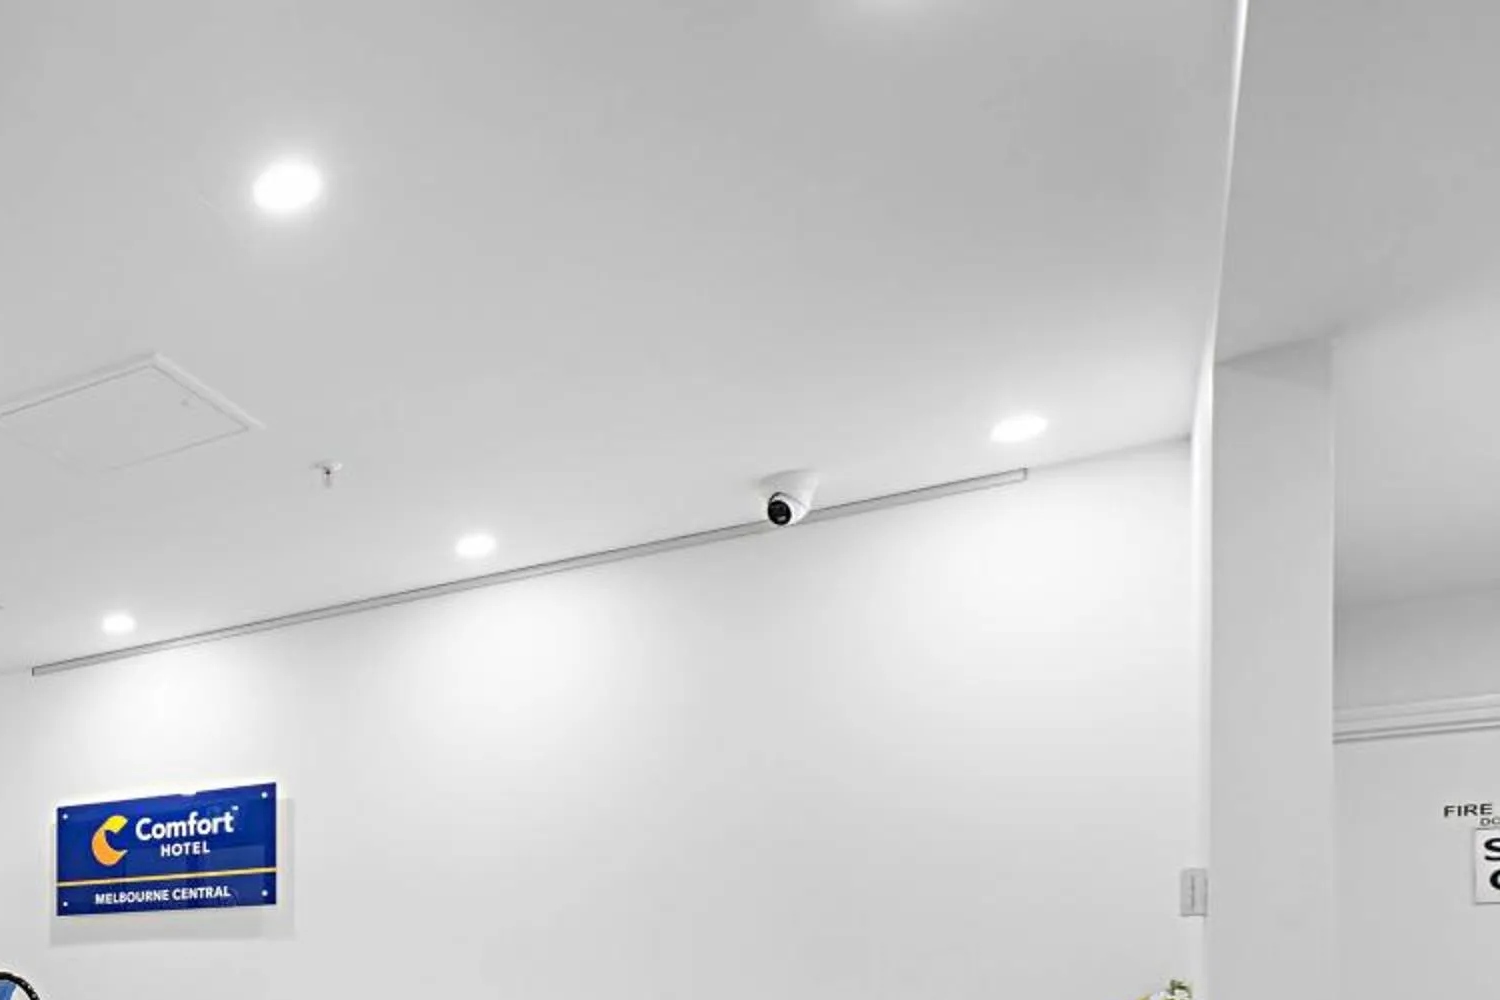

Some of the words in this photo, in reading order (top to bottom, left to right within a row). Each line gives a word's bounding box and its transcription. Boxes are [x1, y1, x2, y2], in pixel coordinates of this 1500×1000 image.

[1443, 803, 1493, 817] FIRE
[135, 811, 234, 840] Comfort
[160, 841, 210, 857] HOTEL
[95, 888, 169, 904] MELBOURNE
[172, 886, 231, 901] CENTRAL
